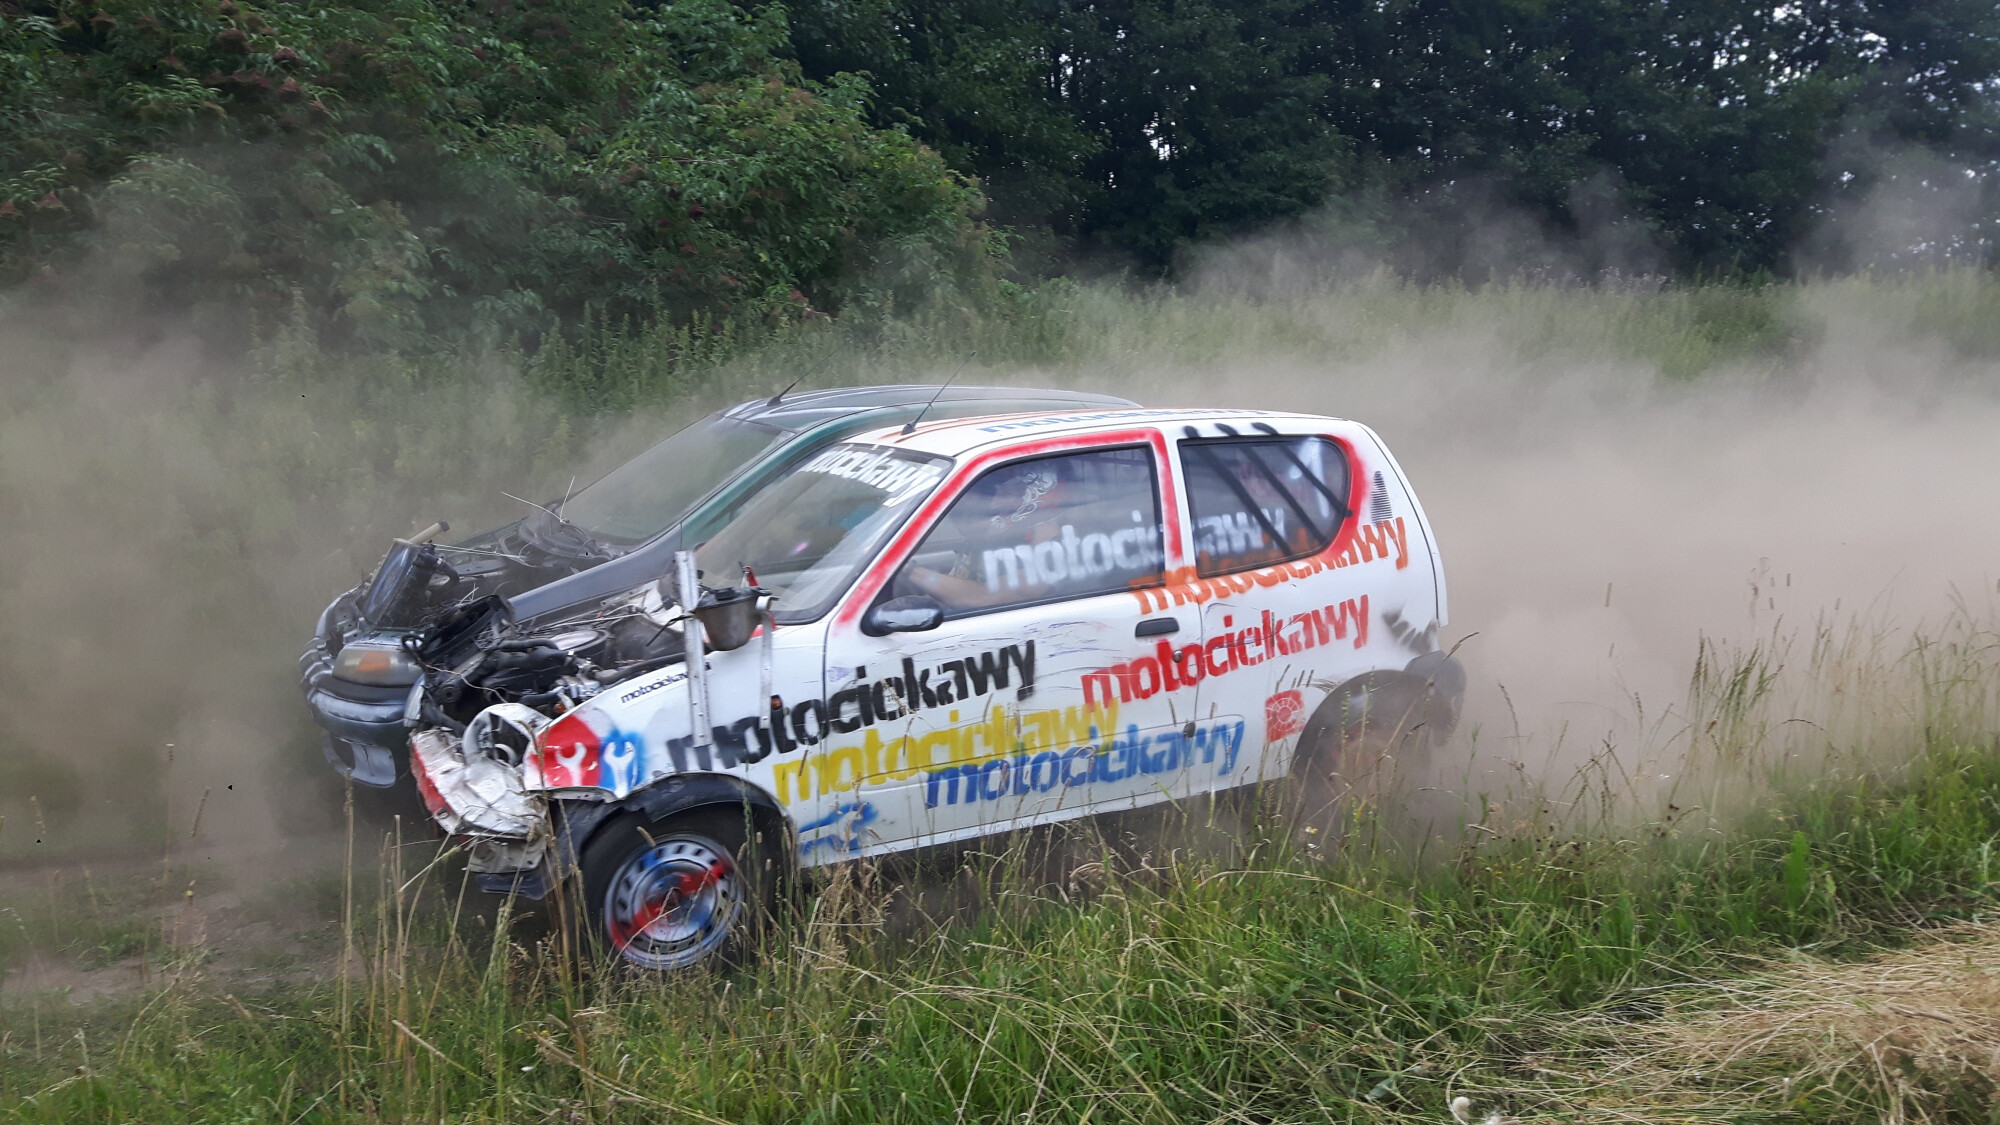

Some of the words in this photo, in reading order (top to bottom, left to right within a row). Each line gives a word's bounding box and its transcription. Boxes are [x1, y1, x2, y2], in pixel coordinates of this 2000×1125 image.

[666, 639, 1035, 772] motociekawy
[1081, 594, 1369, 713] motociekawy
[772, 698, 1118, 806] motociekawy
[926, 720, 1245, 809] motociekawy
